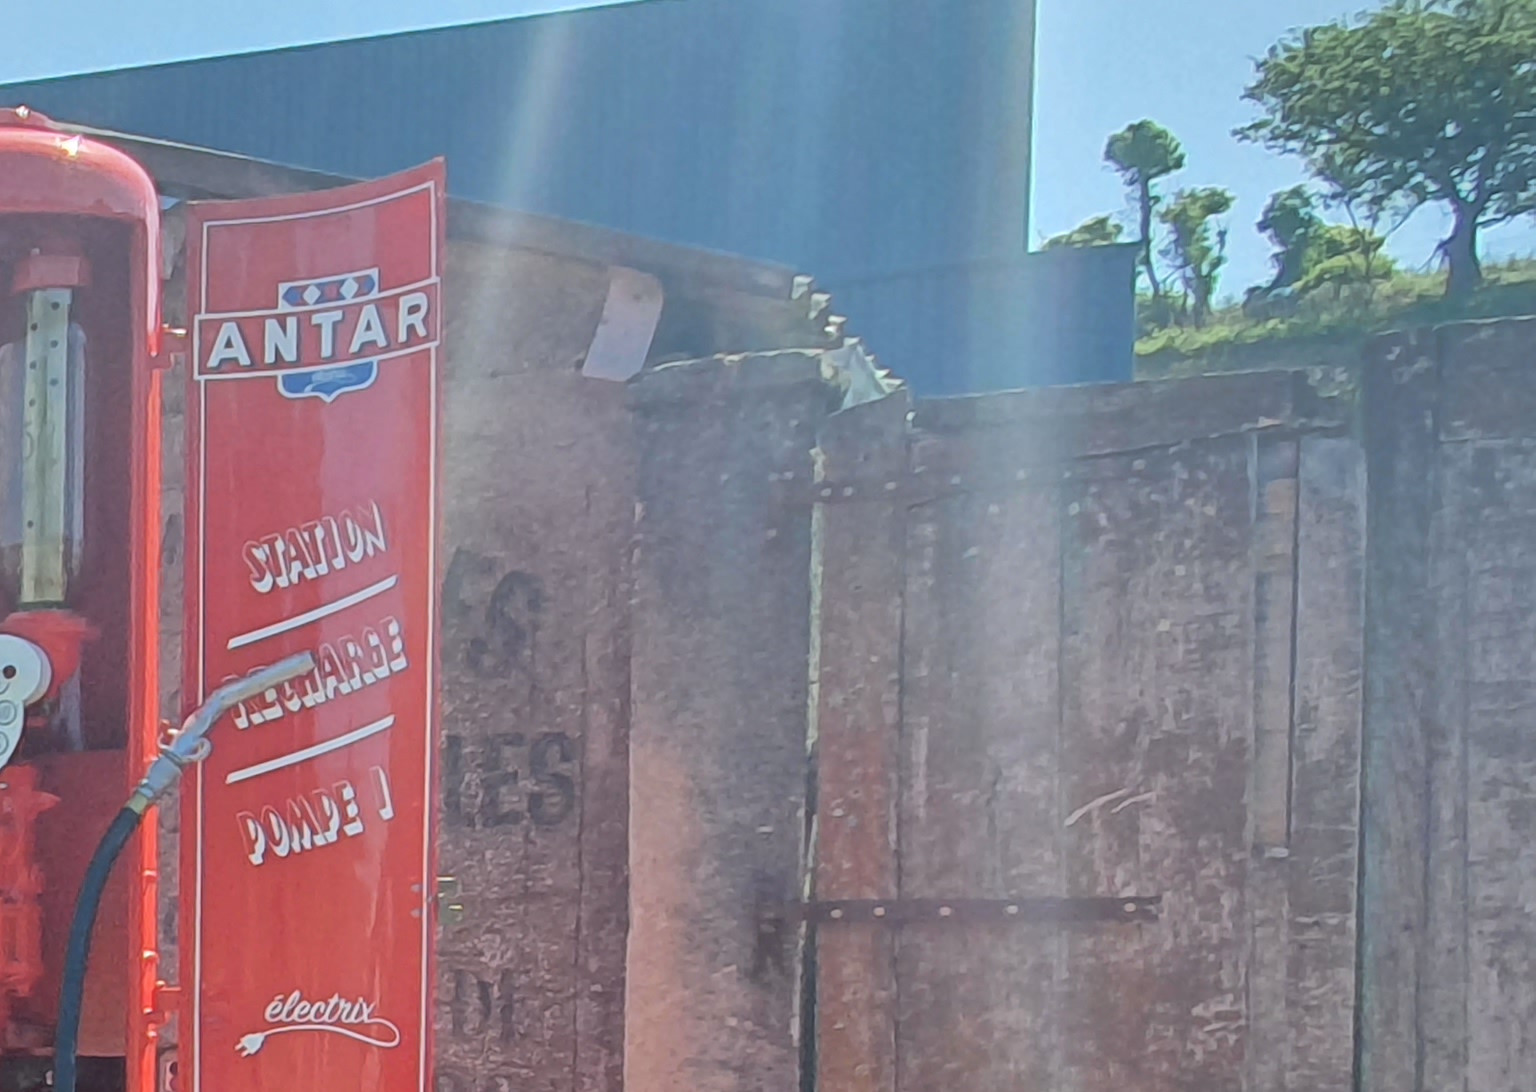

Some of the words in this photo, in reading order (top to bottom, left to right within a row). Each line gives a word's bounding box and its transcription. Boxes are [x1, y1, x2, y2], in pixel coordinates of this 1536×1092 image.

[207, 292, 428, 368] ANTAR
[241, 499, 387, 593] STATION
[236, 779, 364, 867] POMPE
[264, 990, 375, 1024] électrix
